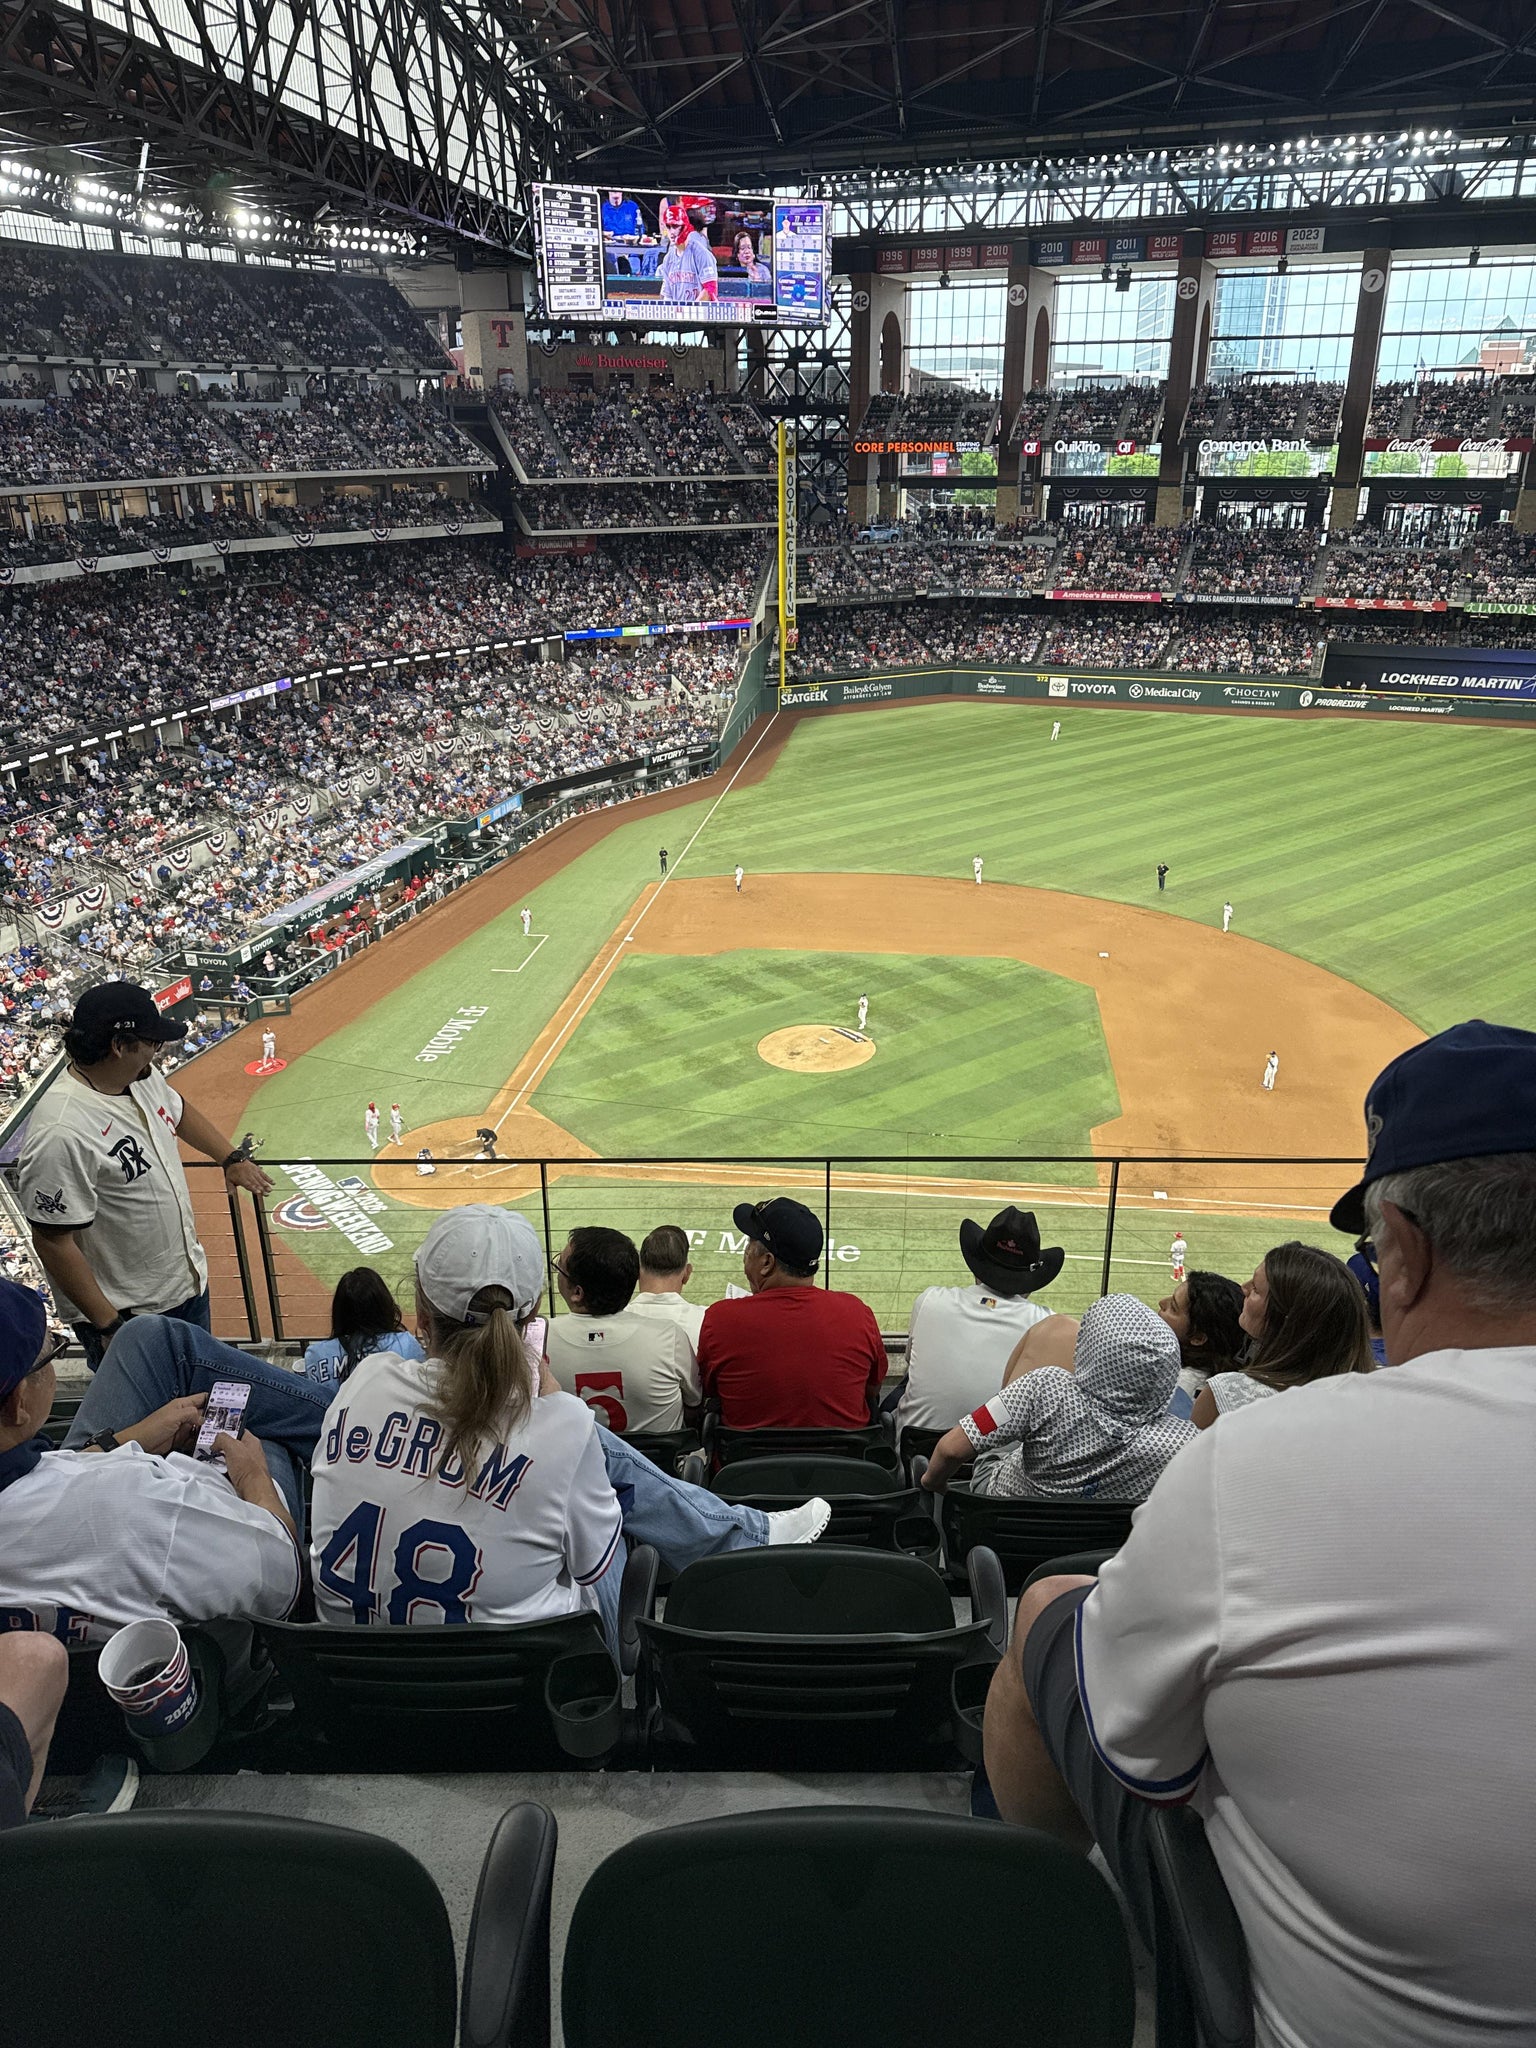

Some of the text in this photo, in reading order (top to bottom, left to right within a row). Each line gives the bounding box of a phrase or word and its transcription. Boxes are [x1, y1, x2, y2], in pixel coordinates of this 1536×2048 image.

[1213, 233, 1237, 245] 2015
[1253, 231, 1278, 243] 2016
[1292, 229, 1319, 241] 2023
[1041, 242, 1063, 253] 2010
[1080, 241, 1100, 252] 2011
[1116, 239, 1137, 250] 2011
[1154, 236, 1178, 248] 2012
[882, 250, 902, 261] 1996
[917, 248, 938, 259] 1998
[951, 247, 972, 258] 1999
[986, 245, 1008, 256] 2010
[1369, 274, 1378, 287] 7
[1180, 282, 1196, 295] 26
[854, 295, 868, 307] 42
[1010, 289, 1026, 301] 34
[491, 320, 514, 347] T
[598, 354, 668, 368] Budweiser
[854, 442, 955, 453] CORE PERSONNEL
[1024, 442, 1038, 453] QT
[1055, 440, 1100, 455] QuikTrip
[1118, 442, 1132, 453] QT
[1271, 438, 1311, 452] Bank
[786, 518, 794, 532] 4
[539, 541, 573, 549] FOUNDATION
[786, 540, 794, 614] CHIKIN
[1102, 592, 1118, 600] Best
[1478, 604, 1526, 614] LUXOR
[1380, 673, 1524, 689] LOCKHEED MARTIN
[1071, 683, 1116, 694] TOYOTA
[1145, 687, 1202, 700] Medical City
[1229, 687, 1280, 698] CHOCTAW
[781, 690, 828, 705] SEATGEEK
[1314, 699, 1369, 708] PROGRESSIVE
[308, 903, 327, 918] Kroger
[251, 938, 274, 953] TOYOTA
[200, 958, 228, 966] TOYOTA
[415, 1018, 478, 1062] Mobile
[354, 1192, 388, 1214] 2026
[320, 1196, 394, 1255] WEEKEND
[575, 1372, 628, 1432] 5
[319, 1500, 483, 1624] 48
[164, 1693, 192, 1725] 2026
